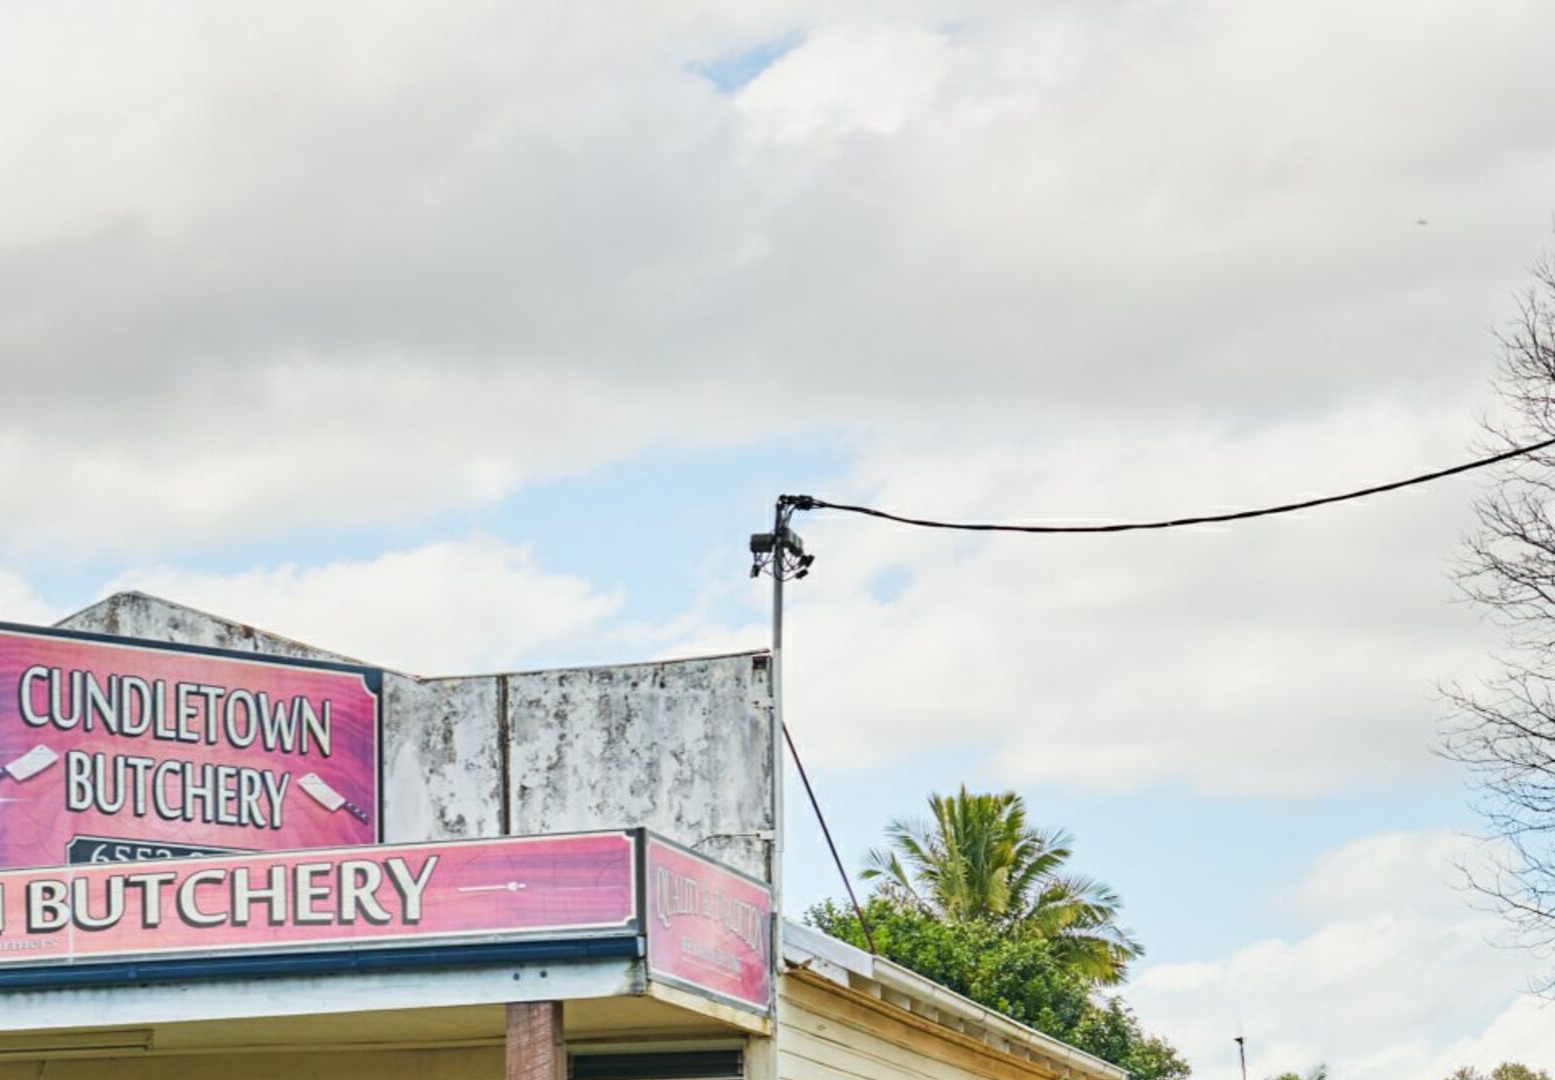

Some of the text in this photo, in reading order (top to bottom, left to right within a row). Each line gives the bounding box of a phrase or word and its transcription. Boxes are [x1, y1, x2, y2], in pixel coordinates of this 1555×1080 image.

[19, 665, 332, 757] CUNDLETOWN
[66, 751, 289, 828] BUTCHERY
[26, 856, 439, 934] BUTCHERY
